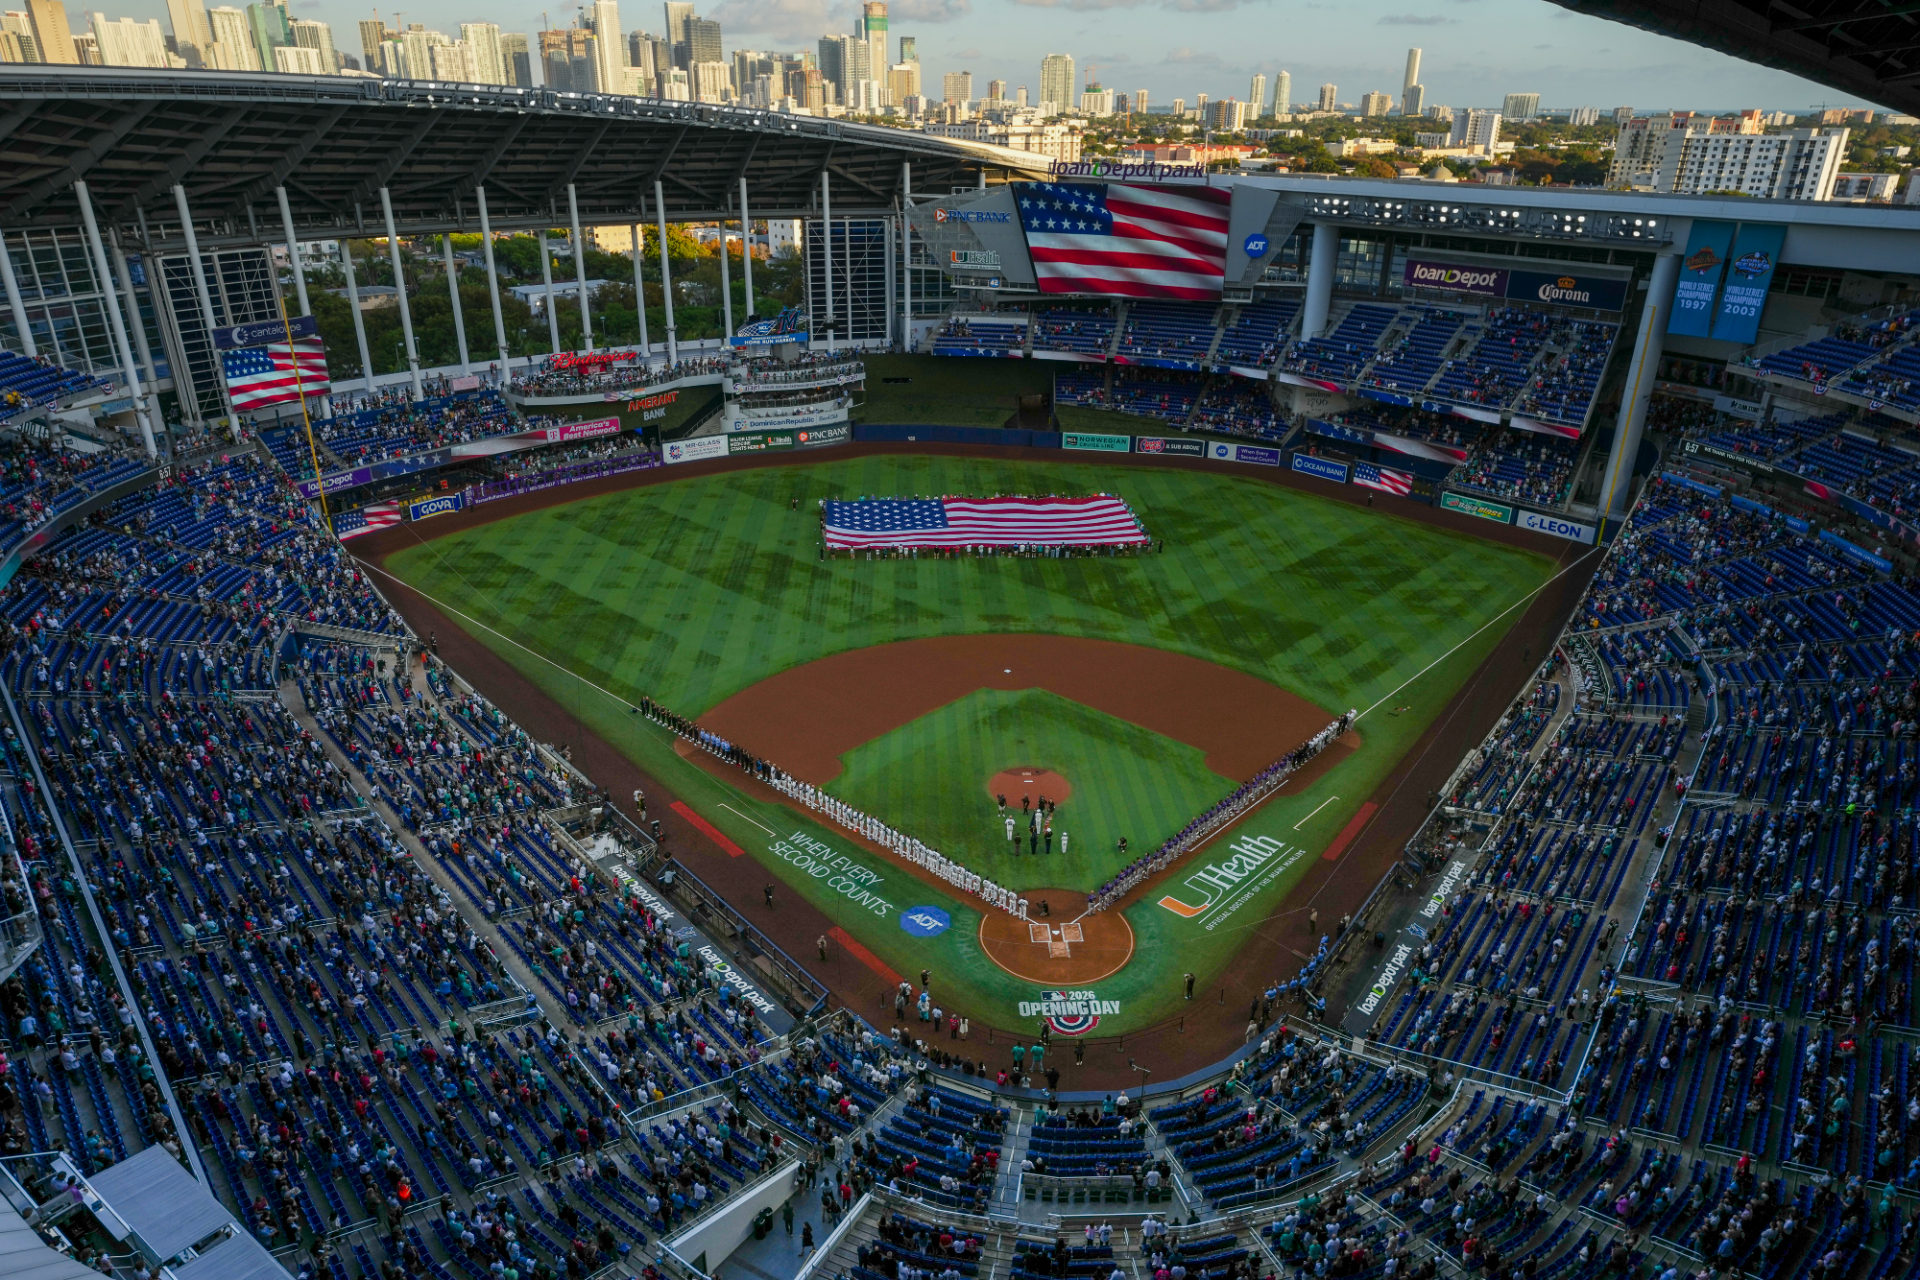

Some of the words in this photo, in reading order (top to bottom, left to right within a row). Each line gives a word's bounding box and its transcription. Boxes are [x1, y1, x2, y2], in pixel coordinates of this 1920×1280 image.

[1052, 158, 1156, 180] loanDepot
[1158, 162, 1206, 181] park
[947, 209, 974, 223] PNC
[976, 210, 1013, 223] BANK
[1246, 240, 1267, 251] ADT
[1413, 264, 1498, 288] loanDepot
[1538, 282, 1591, 303] Corona
[1679, 280, 1698, 291] WORLD
[1697, 282, 1715, 293] SERIES
[1726, 285, 1746, 295] WORLD
[1744, 287, 1765, 298] SERIES
[1677, 289, 1714, 302] CHAMPIONS
[1723, 294, 1763, 307] CHAMPIONS
[1680, 299, 1707, 311] 1997
[1724, 303, 1756, 317] 2003
[550, 351, 638, 369] Budweiser
[628, 390, 680, 412] AMERANT
[643, 408, 667, 421] BANK
[563, 431, 582, 441] Best
[582, 425, 617, 438] Network
[569, 420, 610, 433] America's
[809, 430, 826, 440] PNC
[827, 427, 848, 438] BANK
[1079, 436, 1127, 444] NORWEGIAN
[1684, 441, 1699, 454] 6:57
[158, 466, 172, 480] 6:57
[1303, 461, 1326, 474] OCEAN
[1326, 467, 1345, 478] BANK
[420, 500, 452, 514] GOYA
[1539, 518, 1583, 538] LEON
[768, 840, 831, 879] SECOND
[788, 831, 838, 861] WHEN
[830, 856, 885, 887] EVERY
[1156, 835, 1287, 918] UHealth
[609, 864, 659, 902] loanDepot
[650, 898, 675, 920] park
[1205, 910, 1233, 931] OFFICIAL
[1228, 890, 1255, 912] DOCTORS
[1258, 877, 1272, 887] THE
[1282, 849, 1307, 867] MARLINS
[1420, 874, 1455, 918] loanDepot
[1449, 860, 1467, 881] park
[907, 913, 944, 931] ADT
[697, 945, 753, 994] loanDepot
[744, 990, 777, 1014] park
[1357, 963, 1398, 1016] loanDepot
[1394, 943, 1414, 969] park
[1068, 990, 1096, 1000] 2026
[1018, 1000, 1090, 1017] OPENING
[1089, 999, 1121, 1015] DAY
